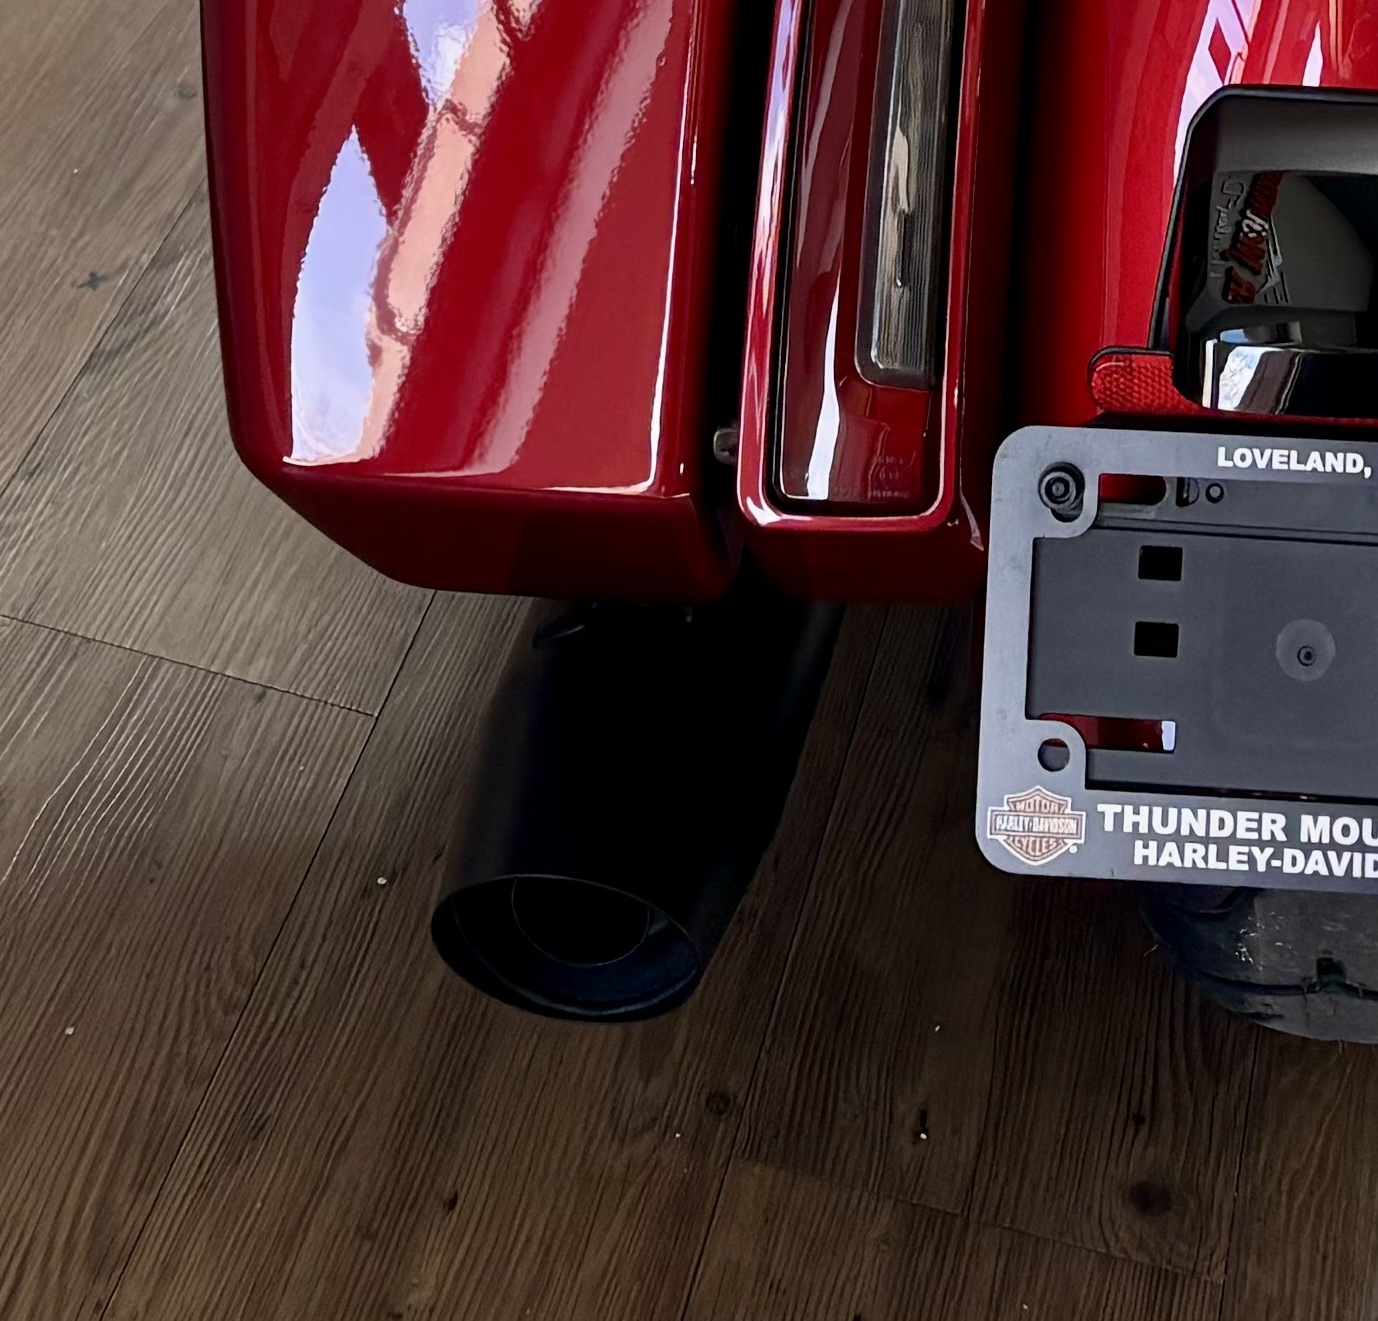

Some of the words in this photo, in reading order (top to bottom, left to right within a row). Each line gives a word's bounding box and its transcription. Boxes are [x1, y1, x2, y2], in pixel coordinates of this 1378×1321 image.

[1217, 446, 1372, 479] LOVELAND,
[1015, 795, 1059, 813] MOTOR
[1097, 804, 1287, 841] THUNDER
[1014, 836, 1058, 857] CYCLES
